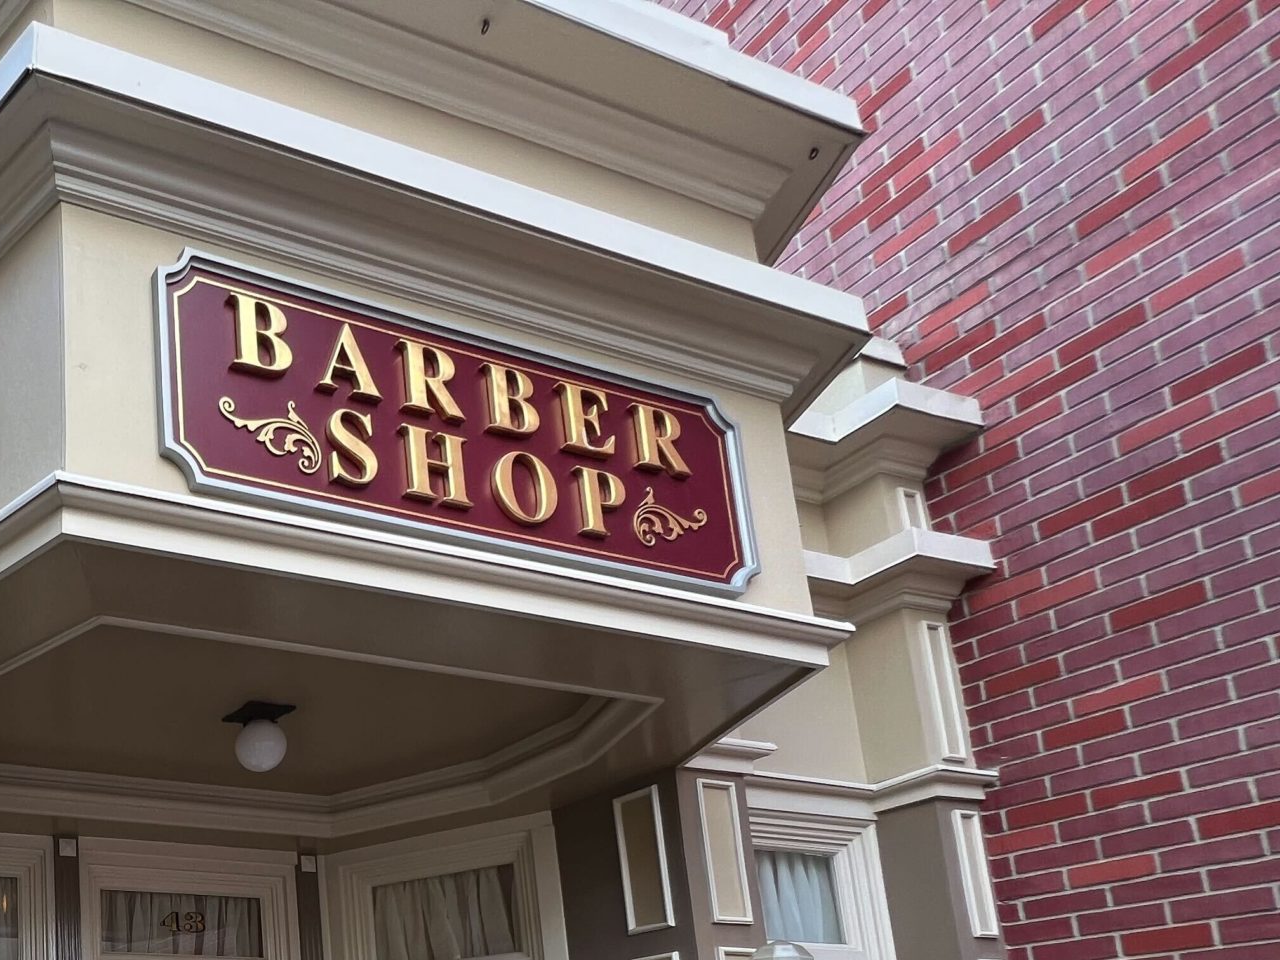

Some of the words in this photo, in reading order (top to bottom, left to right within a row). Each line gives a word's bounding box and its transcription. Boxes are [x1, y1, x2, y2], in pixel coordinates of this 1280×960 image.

[225, 290, 692, 480] BARBER
[324, 407, 627, 539] SHOP
[159, 911, 206, 934] 43
